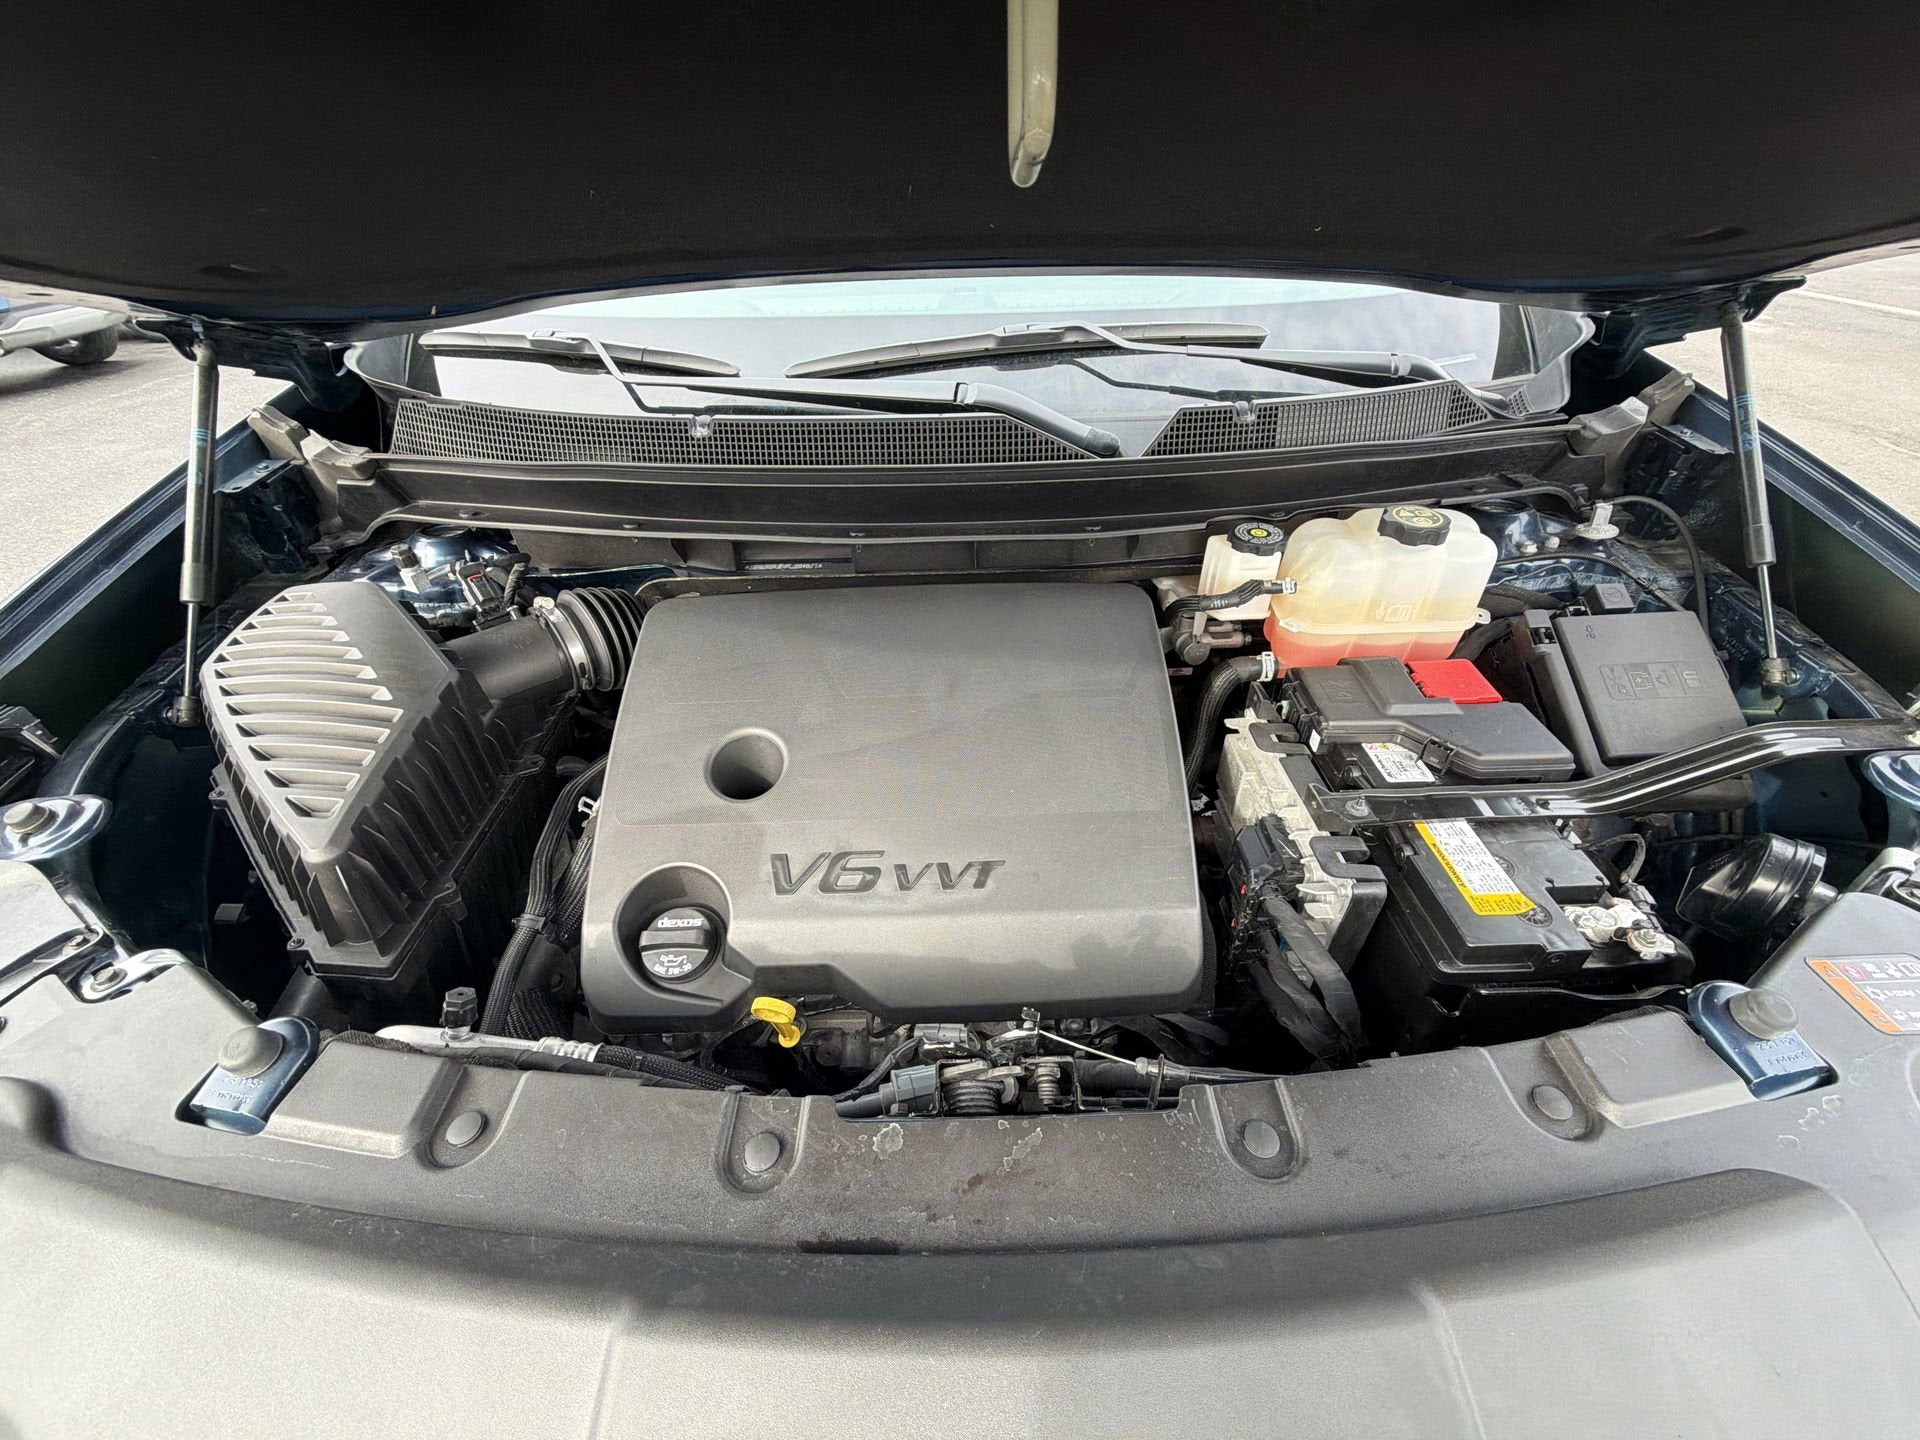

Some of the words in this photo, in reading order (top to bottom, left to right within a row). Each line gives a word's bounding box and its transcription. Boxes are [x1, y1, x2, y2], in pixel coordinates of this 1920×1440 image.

[769, 850, 885, 896] V6
[893, 859, 1006, 892] VVT
[657, 916, 705, 928] dexos
[653, 963, 668, 975] SAE
[668, 962, 692, 975] 5W-30
